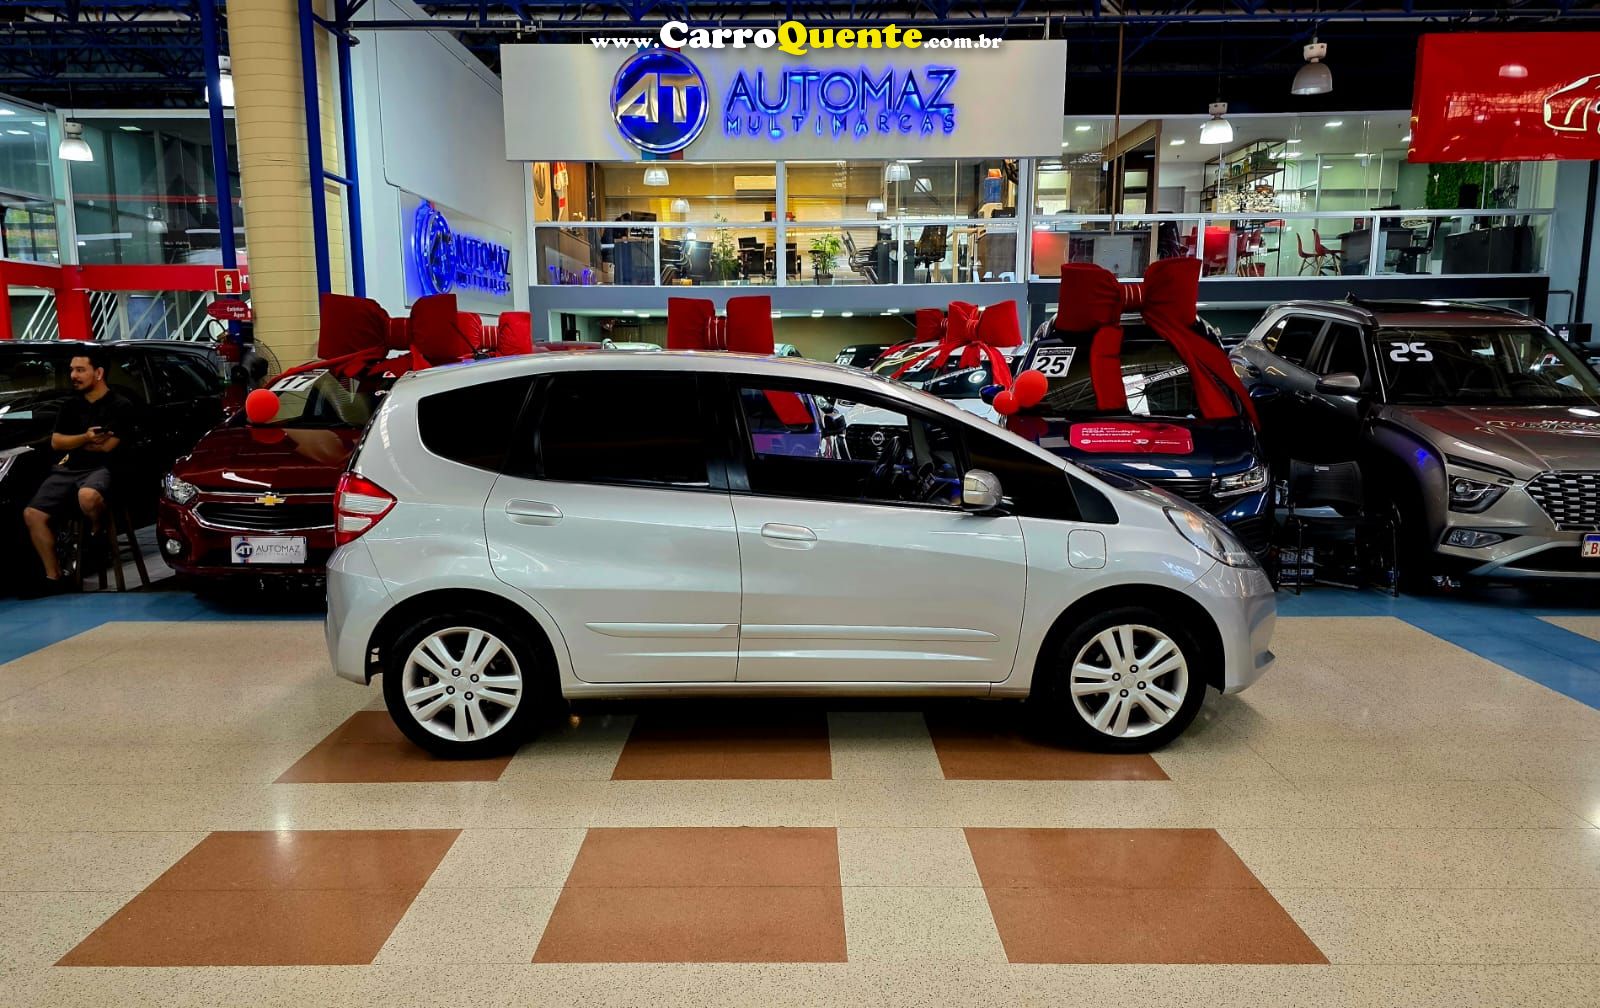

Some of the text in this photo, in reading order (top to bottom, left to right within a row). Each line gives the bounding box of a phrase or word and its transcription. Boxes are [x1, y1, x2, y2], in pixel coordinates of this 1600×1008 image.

[726, 69, 957, 113] AUTOMAZ
[726, 114, 956, 136] MULTIMARCAS
[1390, 342, 1434, 362] 25
[1036, 356, 1067, 374] 25
[280, 376, 316, 389] 17
[255, 544, 300, 553] AUTOMAZ
